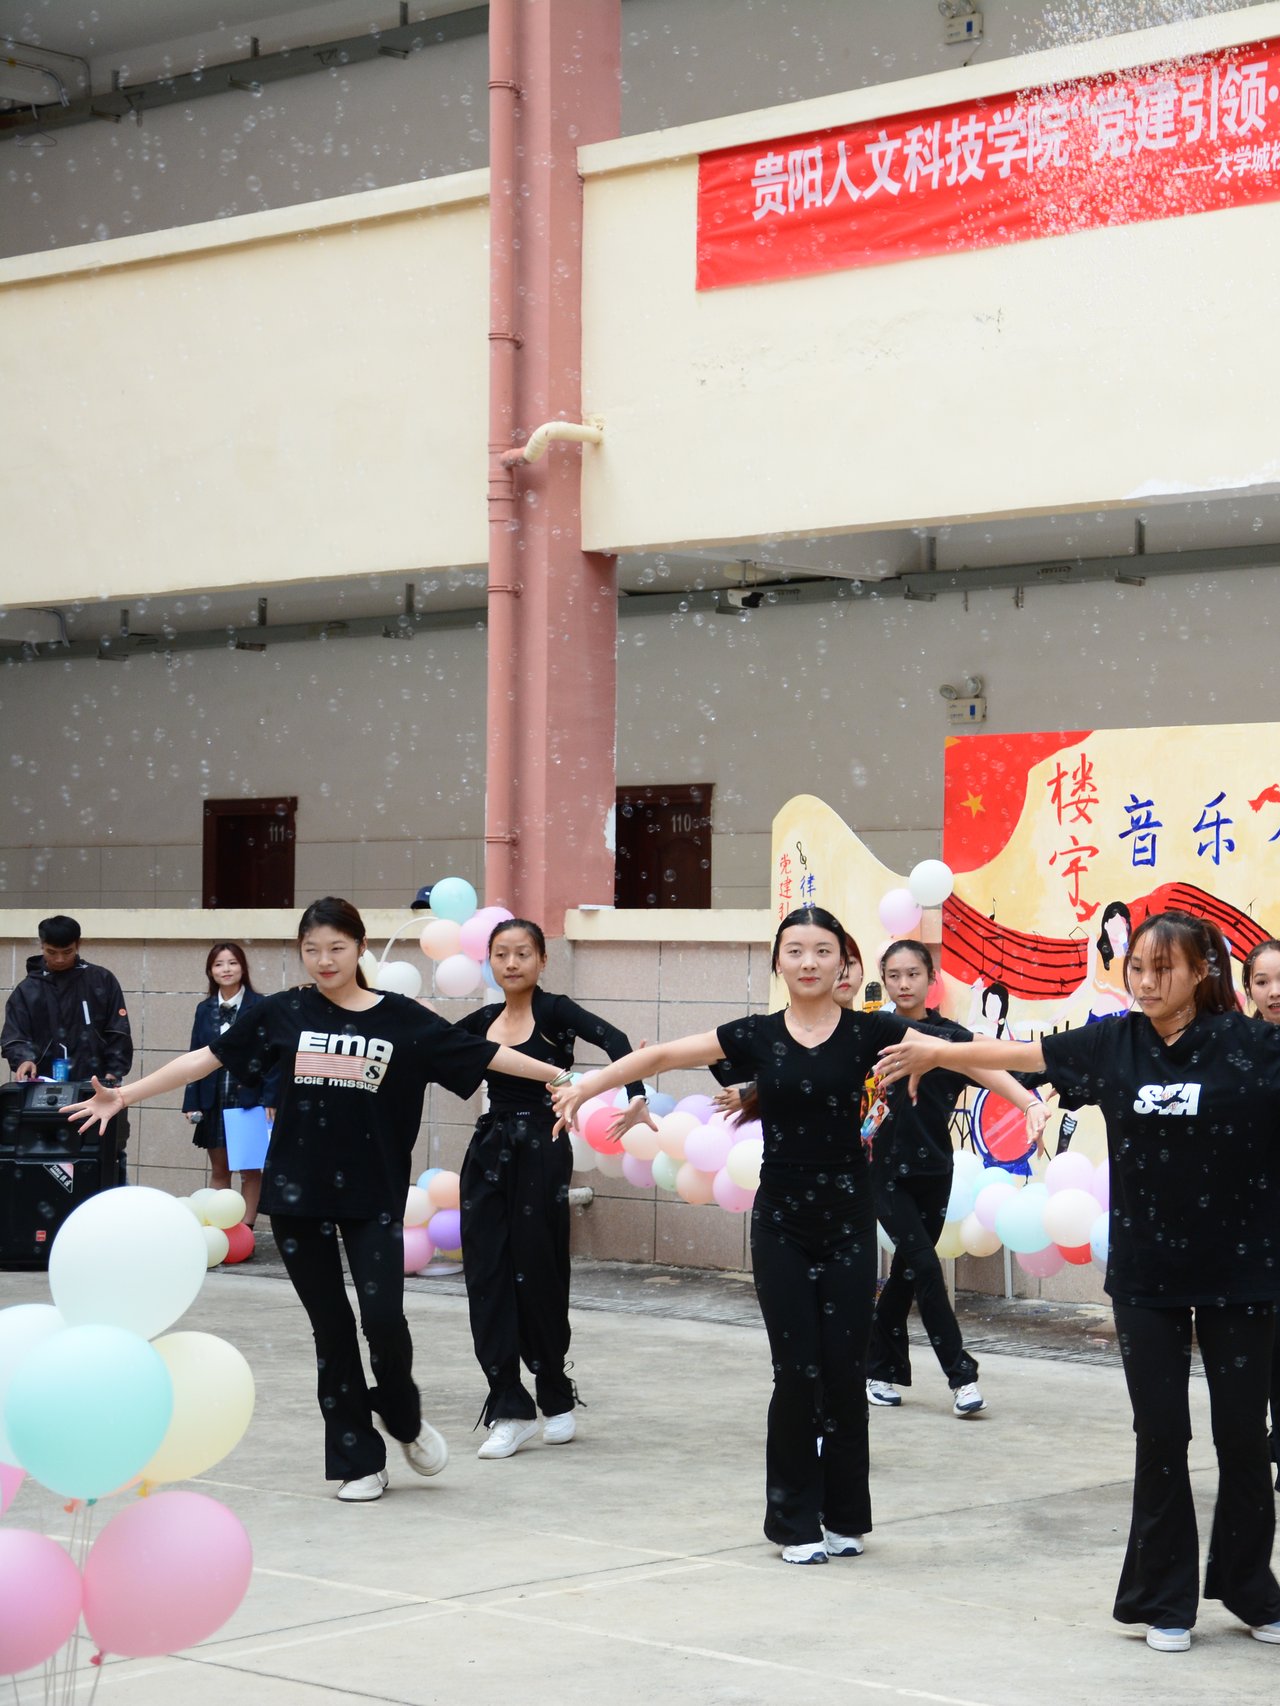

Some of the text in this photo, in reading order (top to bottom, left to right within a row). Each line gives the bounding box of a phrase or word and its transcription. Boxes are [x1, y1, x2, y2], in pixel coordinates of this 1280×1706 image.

[671, 813, 692, 833] 110
[1046, 753, 1100, 908] 楼宇
[269, 824, 285, 842] 111
[365, 1065, 381, 1080] S
